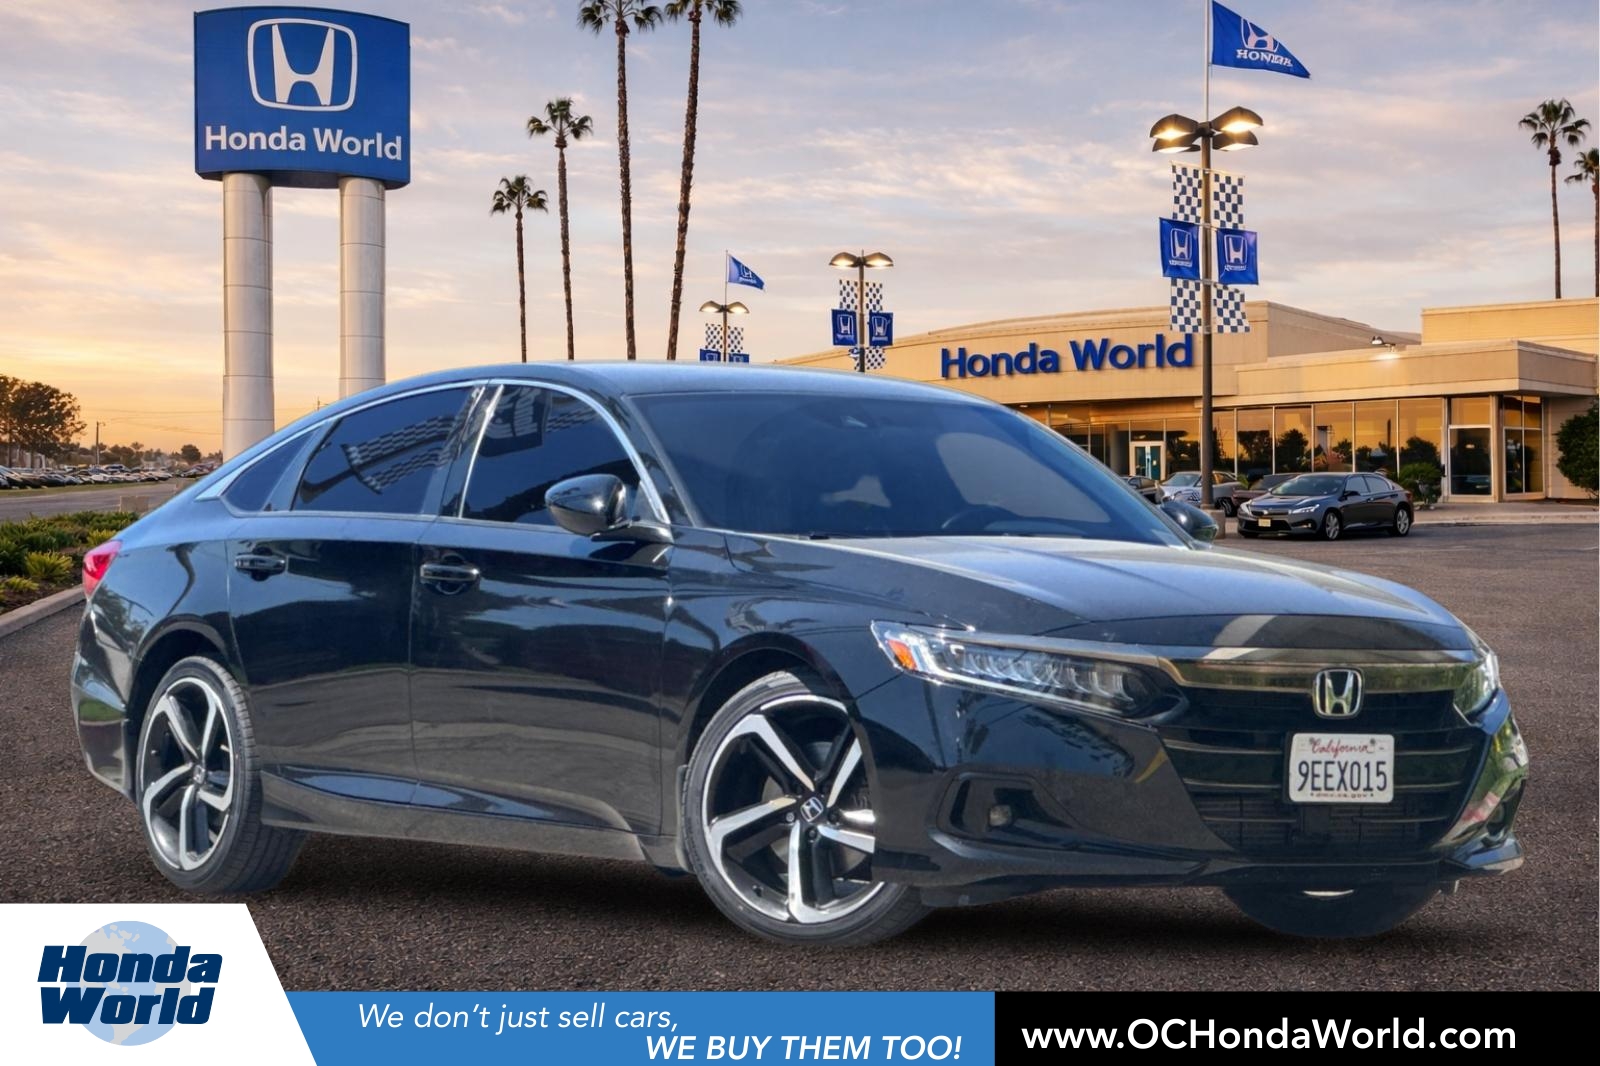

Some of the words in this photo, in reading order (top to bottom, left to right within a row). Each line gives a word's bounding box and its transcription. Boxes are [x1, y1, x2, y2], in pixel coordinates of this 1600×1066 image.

[205, 125, 306, 151] Honda
[313, 127, 402, 160] World
[941, 343, 1060, 378] Honda
[1070, 333, 1194, 370] World
[1311, 738, 1371, 758] California
[1297, 760, 1387, 791] 9EEX015
